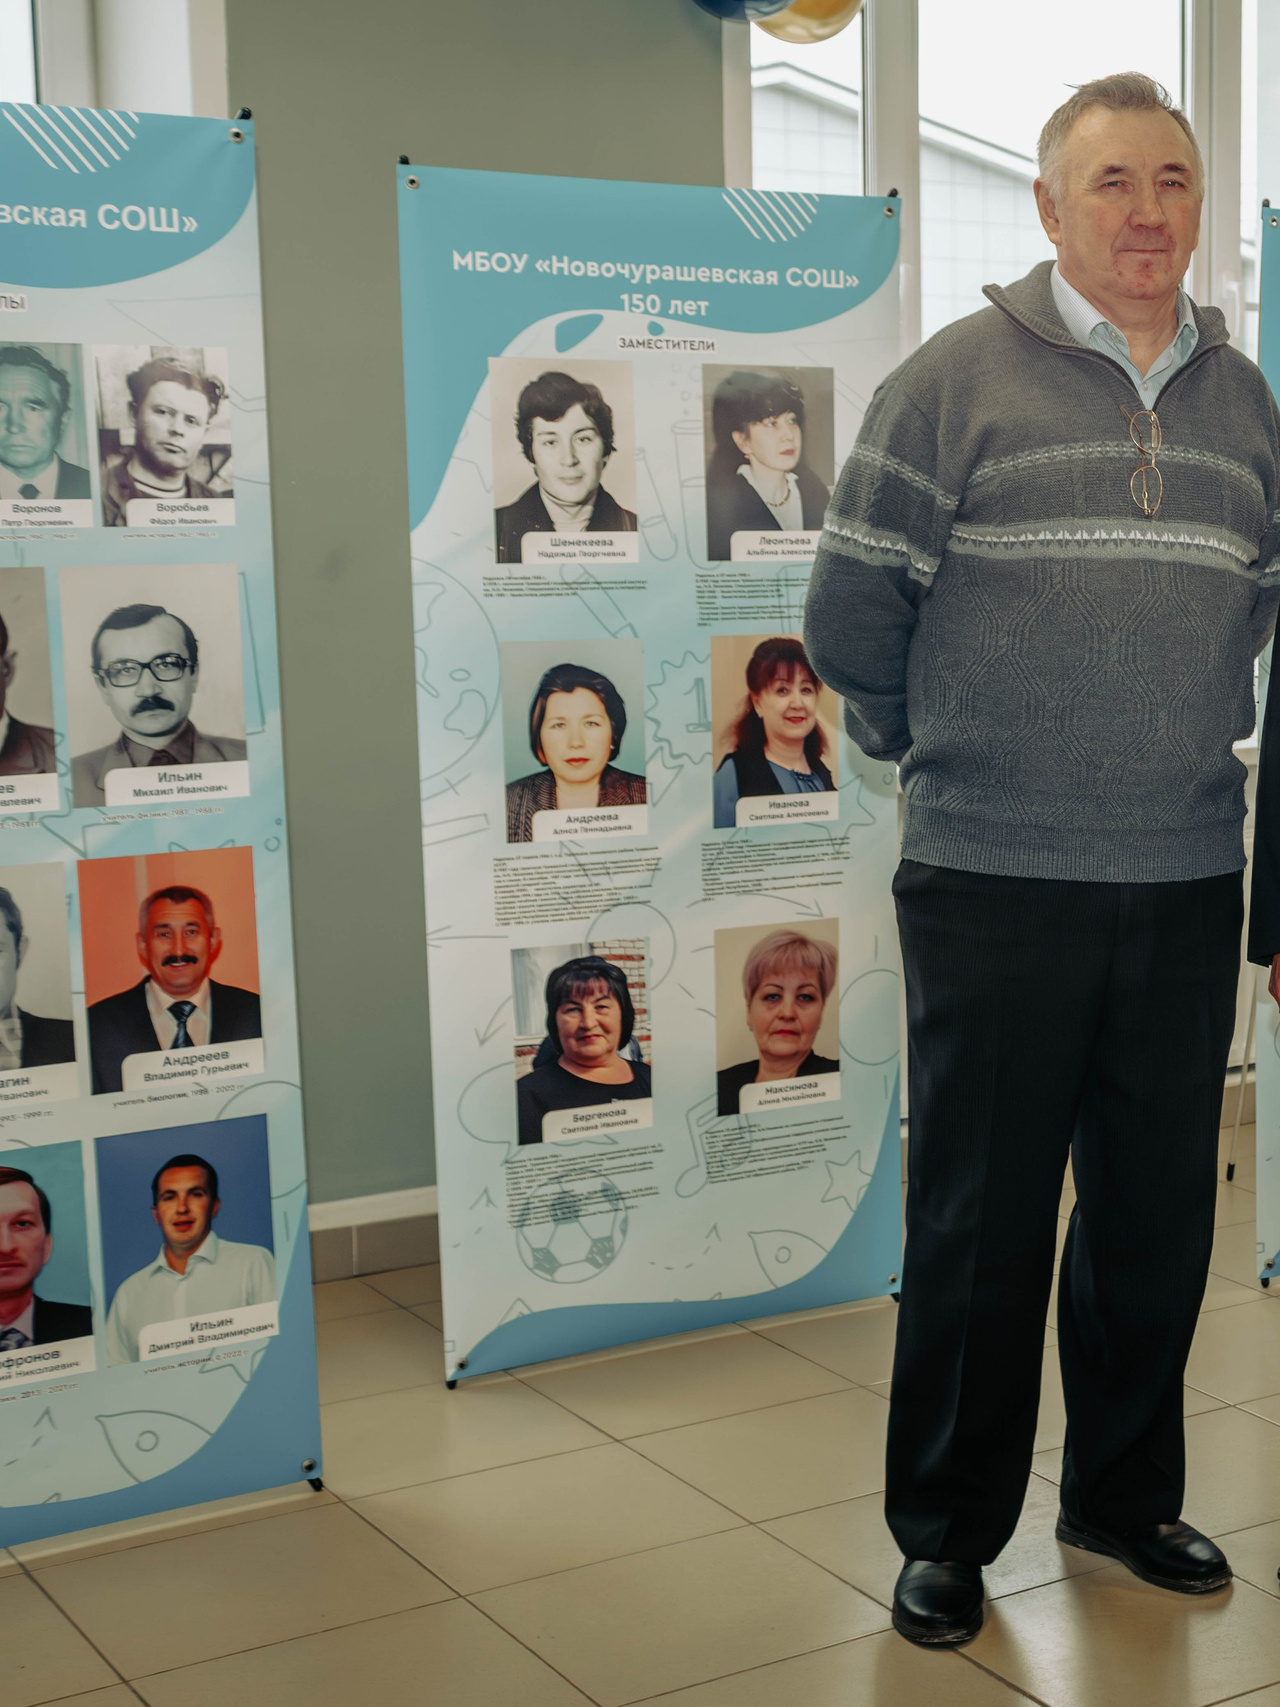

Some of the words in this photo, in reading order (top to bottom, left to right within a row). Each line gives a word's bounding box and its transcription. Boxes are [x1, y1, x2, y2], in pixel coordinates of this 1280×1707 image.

[0, 204, 87, 228] вская
[97, 203, 199, 233] СОШ»
[452, 249, 529, 274] МБОУ
[534, 255, 779, 286] «Новочурашевская
[785, 266, 860, 289] СОШ»
[0, 295, 26, 310] ЛЫ
[619, 293, 662, 315] 150
[668, 299, 710, 316] лет
[618, 337, 715, 351] ЗАМЕСТИТЕЛИ
[12, 503, 62, 515] Воронов
[156, 503, 209, 514] Воробьев
[178, 517, 218, 525] Иванович
[550, 537, 614, 547] Шемекеева
[759, 536, 811, 546] Леонтьева
[537, 550, 577, 558] Надежда
[781, 548, 816, 556] Алексеев
[157, 772, 203, 783] Ильин
[132, 788, 174, 798] Михаил
[176, 785, 228, 794] Иванович
[768, 799, 810, 810] Иванова
[565, 812, 619, 825] Андреева
[749, 812, 785, 822] Светлана
[785, 809, 830, 819] Алексеевна
[552, 827, 579, 836] Алиса
[580, 823, 633, 834] Геннадьевна
[143, 1066, 199, 1082] Владимир
[201, 1061, 250, 1075] Гурьевич
[0, 1076, 30, 1089] агин
[765, 1080, 819, 1096] Максимова
[572, 1107, 628, 1124] Бергенова
[560, 1123, 599, 1135] Светлана
[600, 1117, 639, 1129] Ивановна
[189, 1317, 234, 1333] Ильин
[148, 1338, 195, 1354] Дмитрий
[197, 1322, 275, 1344] Владимирович
[0, 1350, 61, 1371] фронов
[15, 1361, 80, 1378] Николаевич
